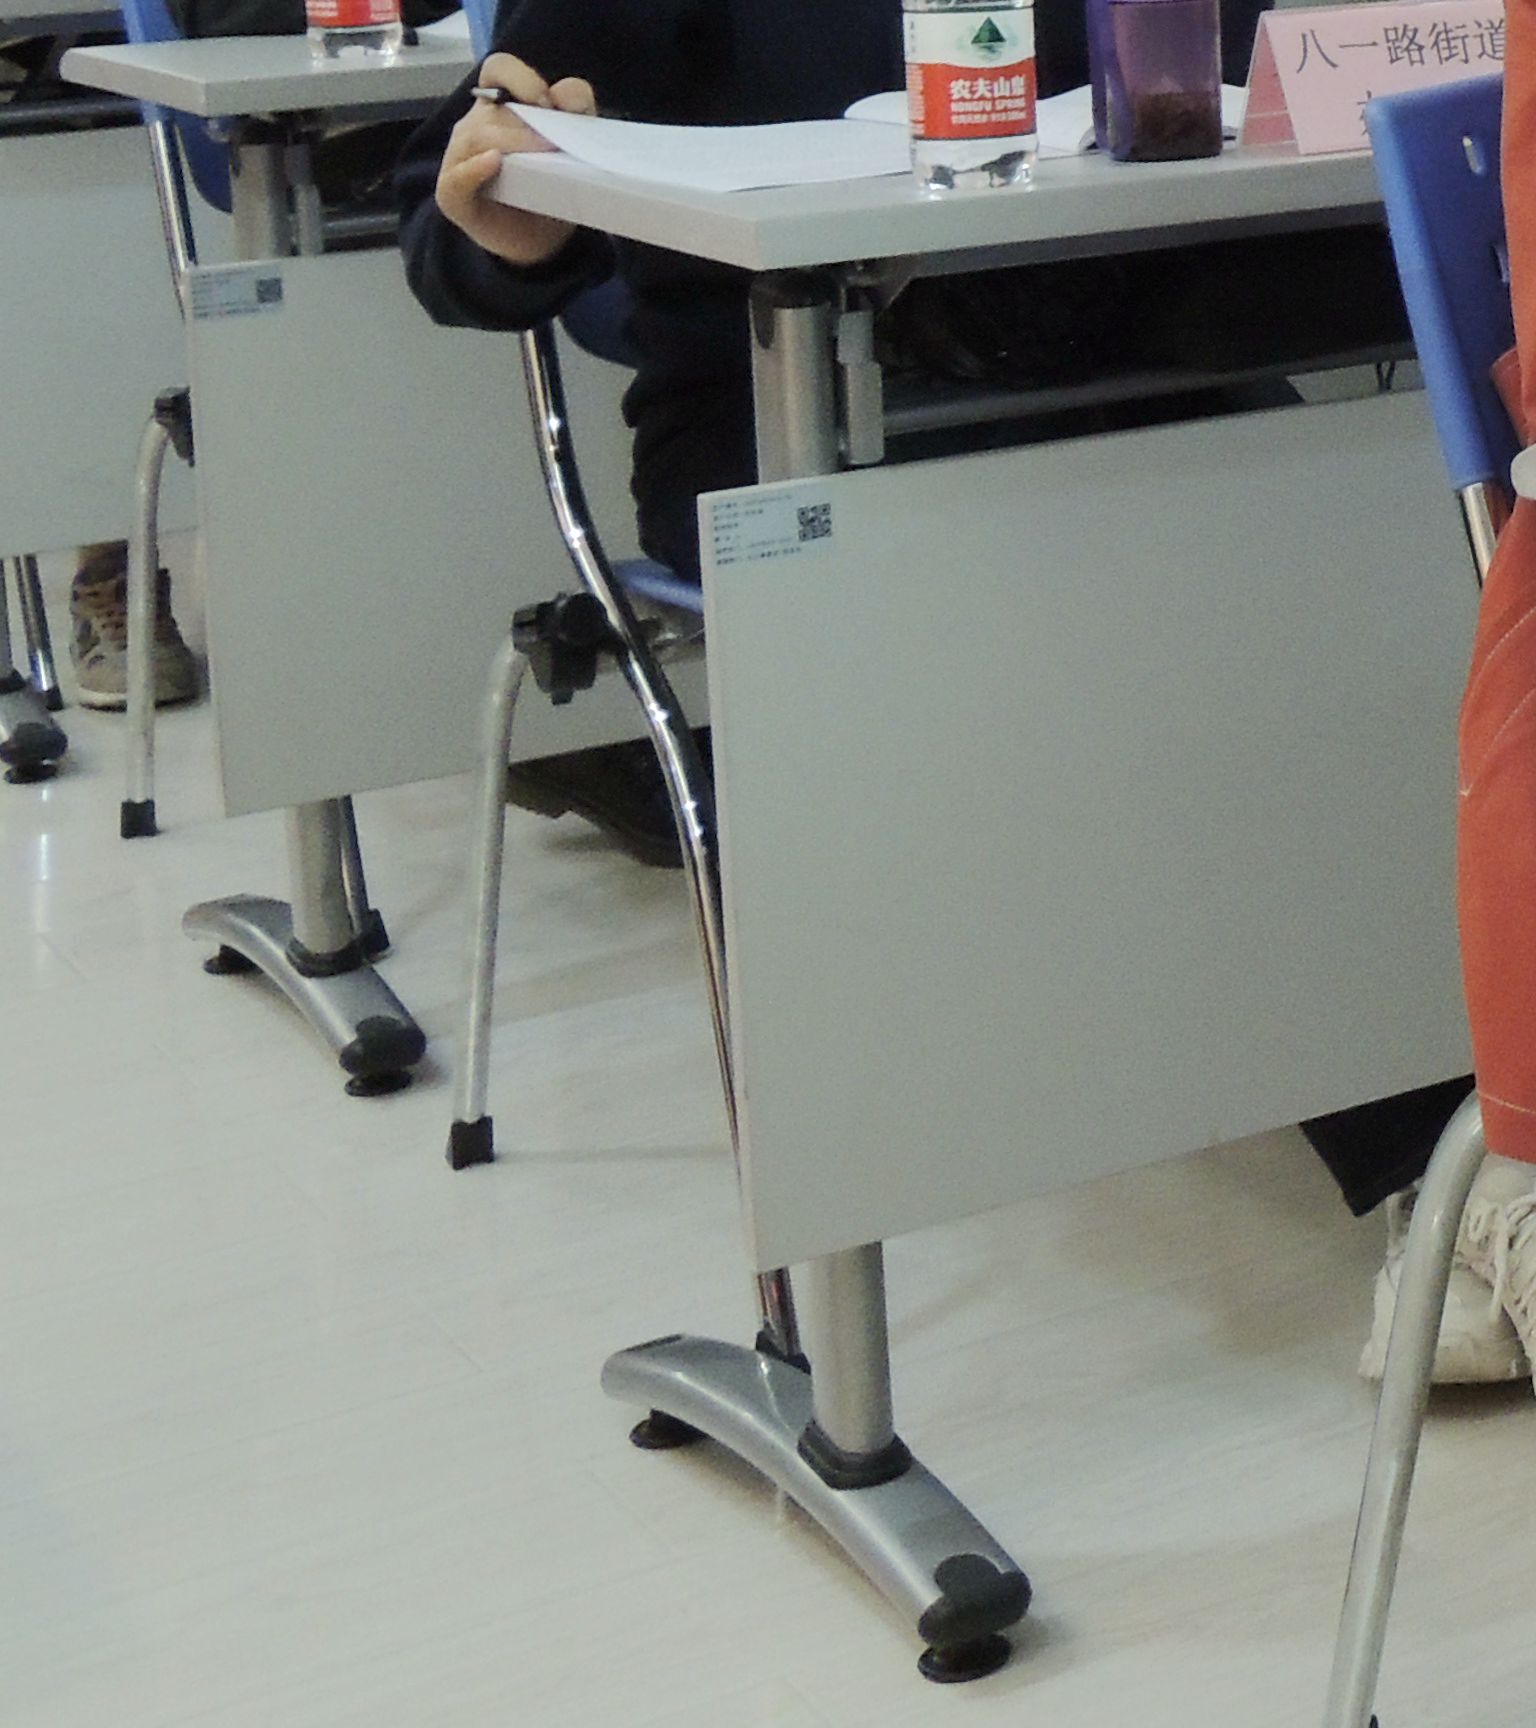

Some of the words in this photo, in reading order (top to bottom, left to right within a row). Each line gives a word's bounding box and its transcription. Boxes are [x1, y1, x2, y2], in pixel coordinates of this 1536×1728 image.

[1296, 19, 1505, 74] 八一路街道
